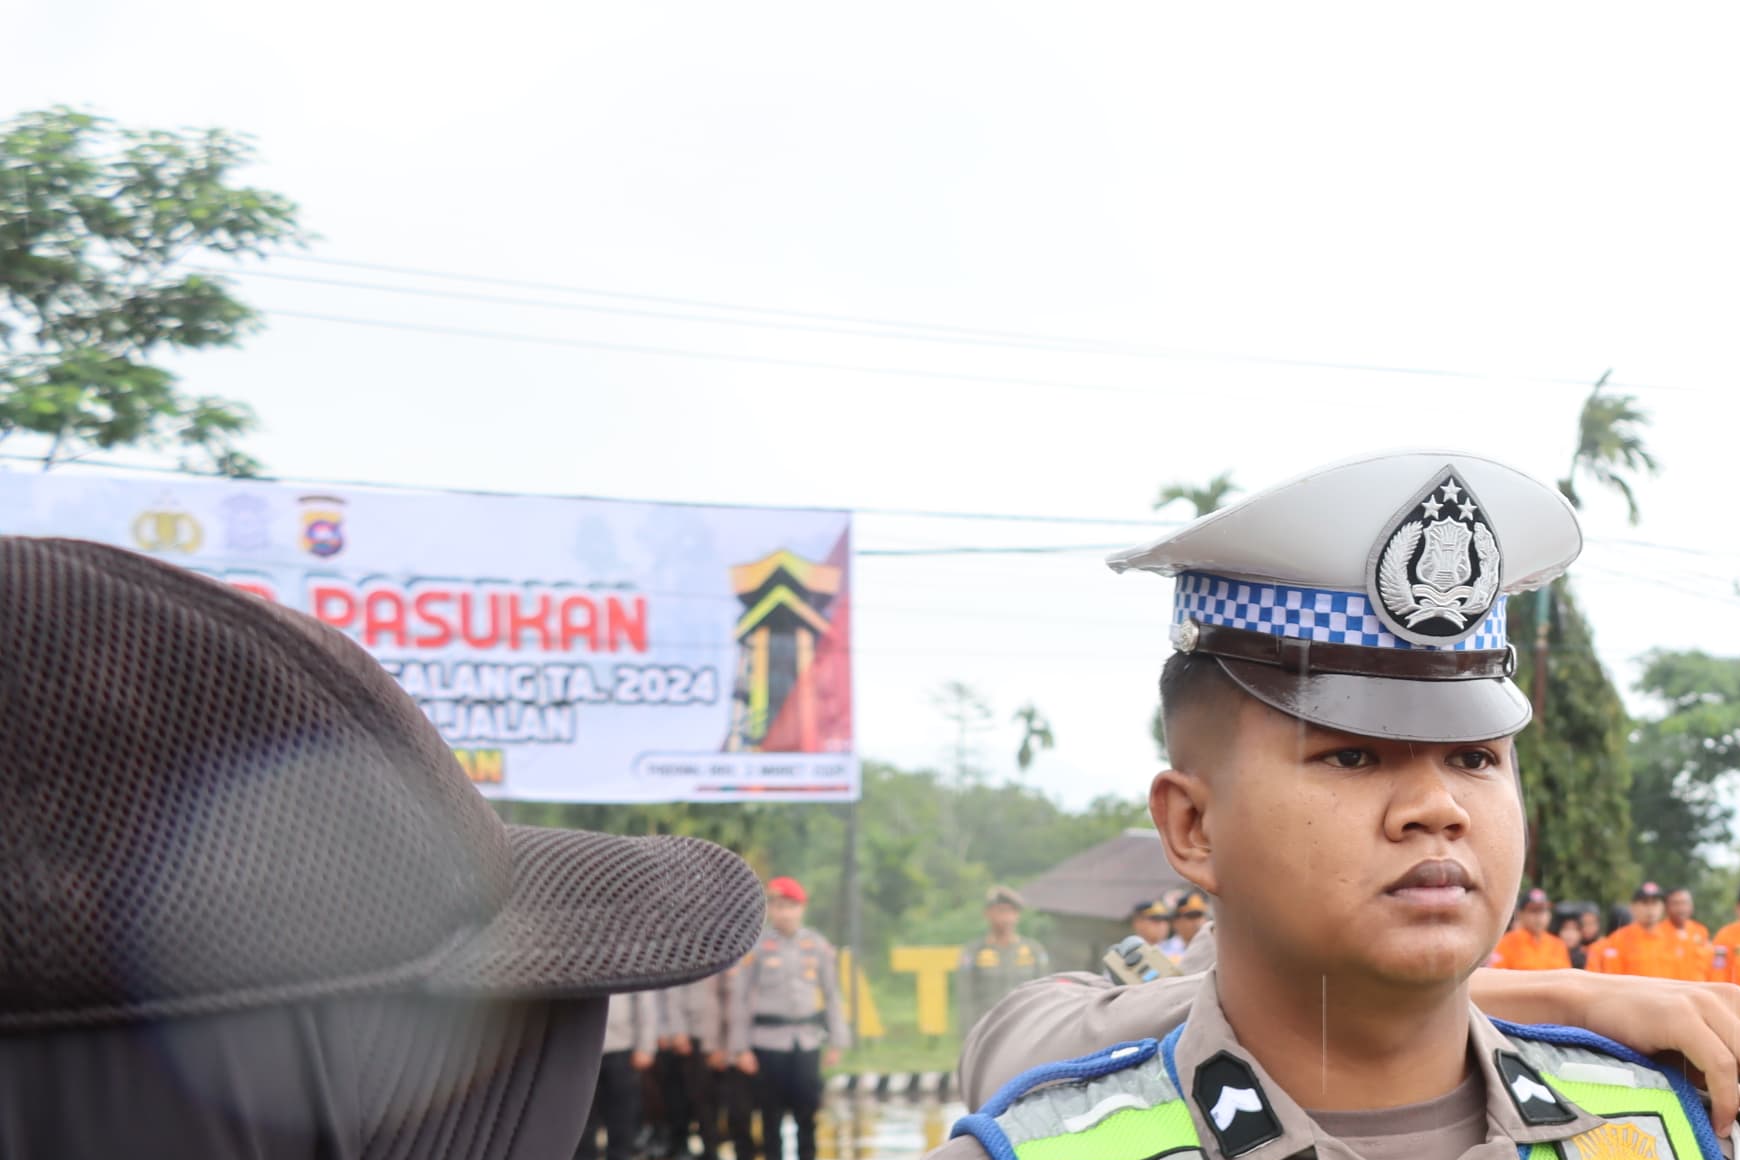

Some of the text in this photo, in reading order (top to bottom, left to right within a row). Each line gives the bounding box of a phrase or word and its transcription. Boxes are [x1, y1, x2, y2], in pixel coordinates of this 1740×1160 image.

[311, 585, 648, 654] PASUKAN
[384, 663, 531, 700] ALANG
[613, 666, 717, 703] 2024
